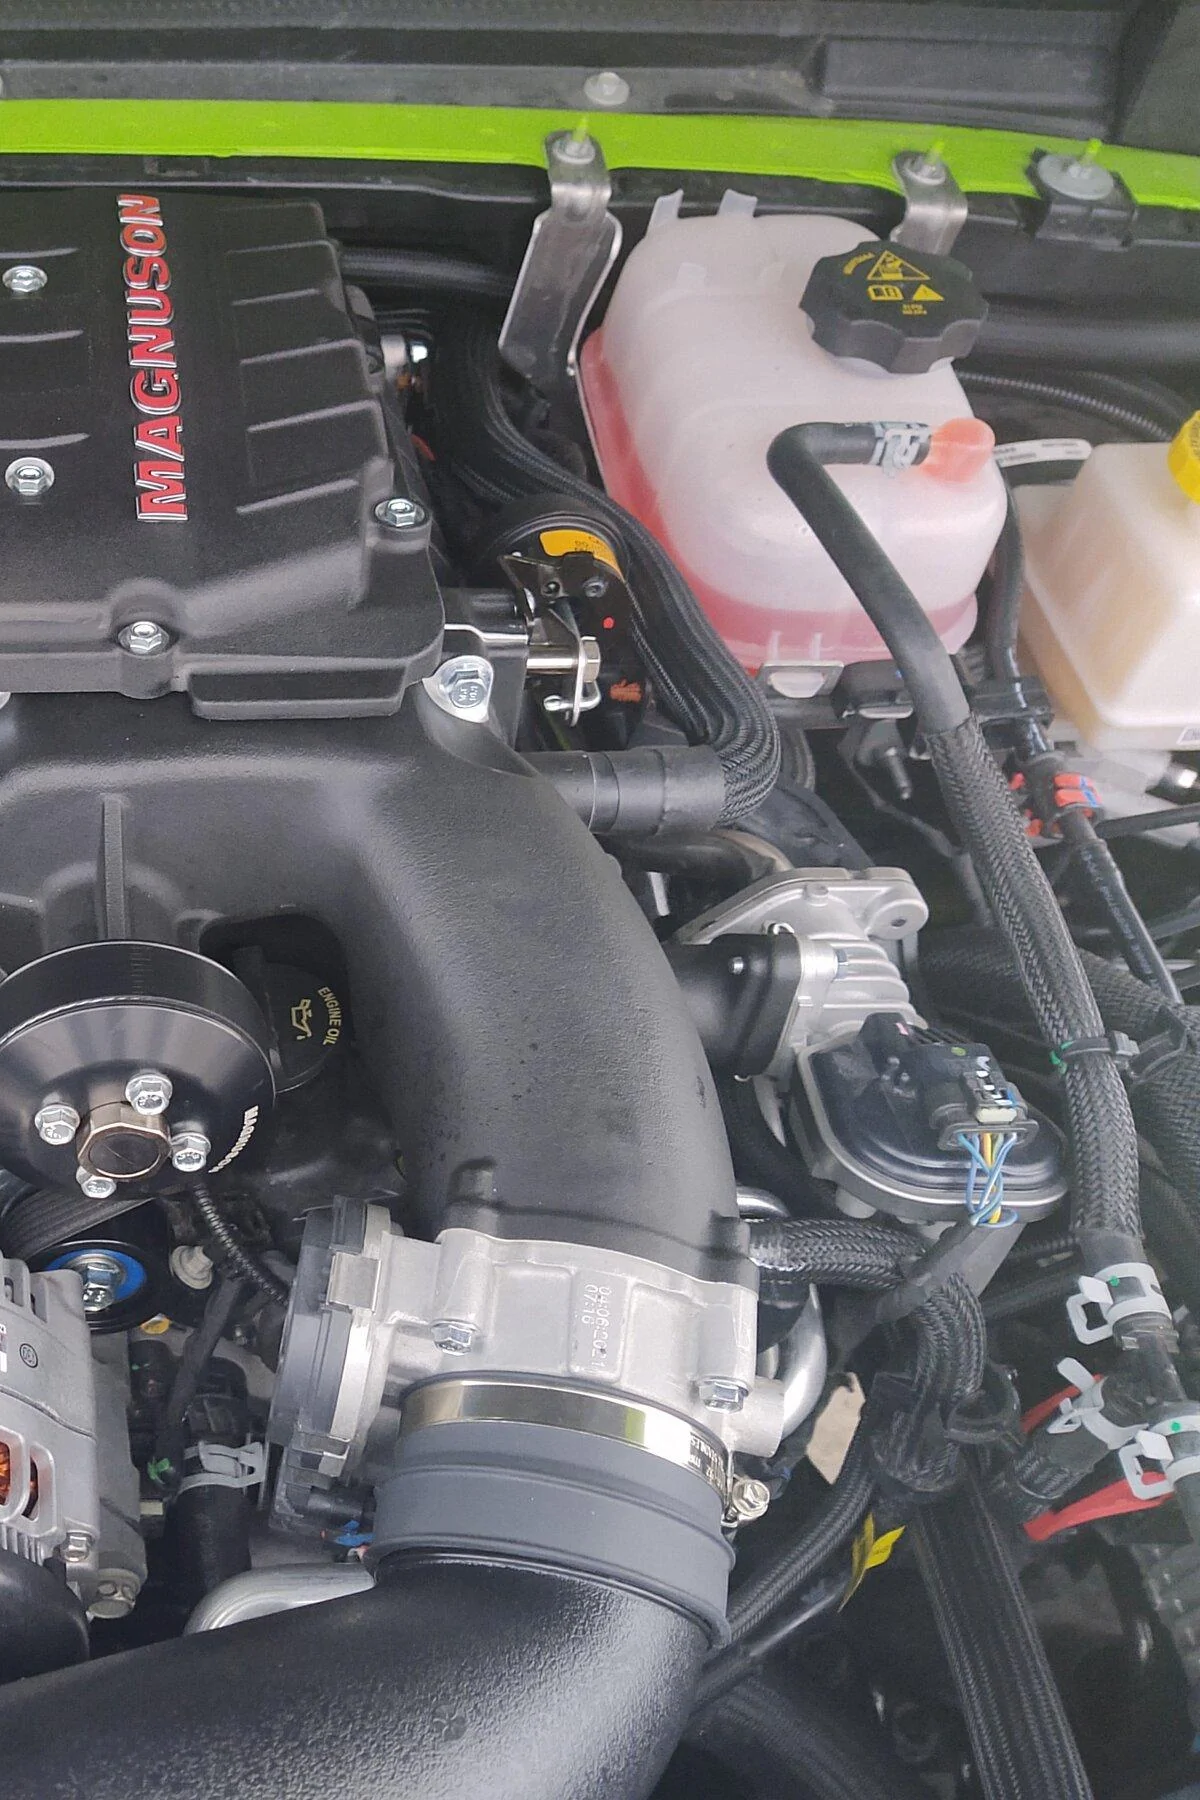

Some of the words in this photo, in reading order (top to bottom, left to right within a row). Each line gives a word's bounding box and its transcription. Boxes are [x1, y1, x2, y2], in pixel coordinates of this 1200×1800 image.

[117, 194, 188, 522] MAGNUSON
[317, 986, 342, 1026] ENGINE
[322, 1028, 340, 1045] OIL
